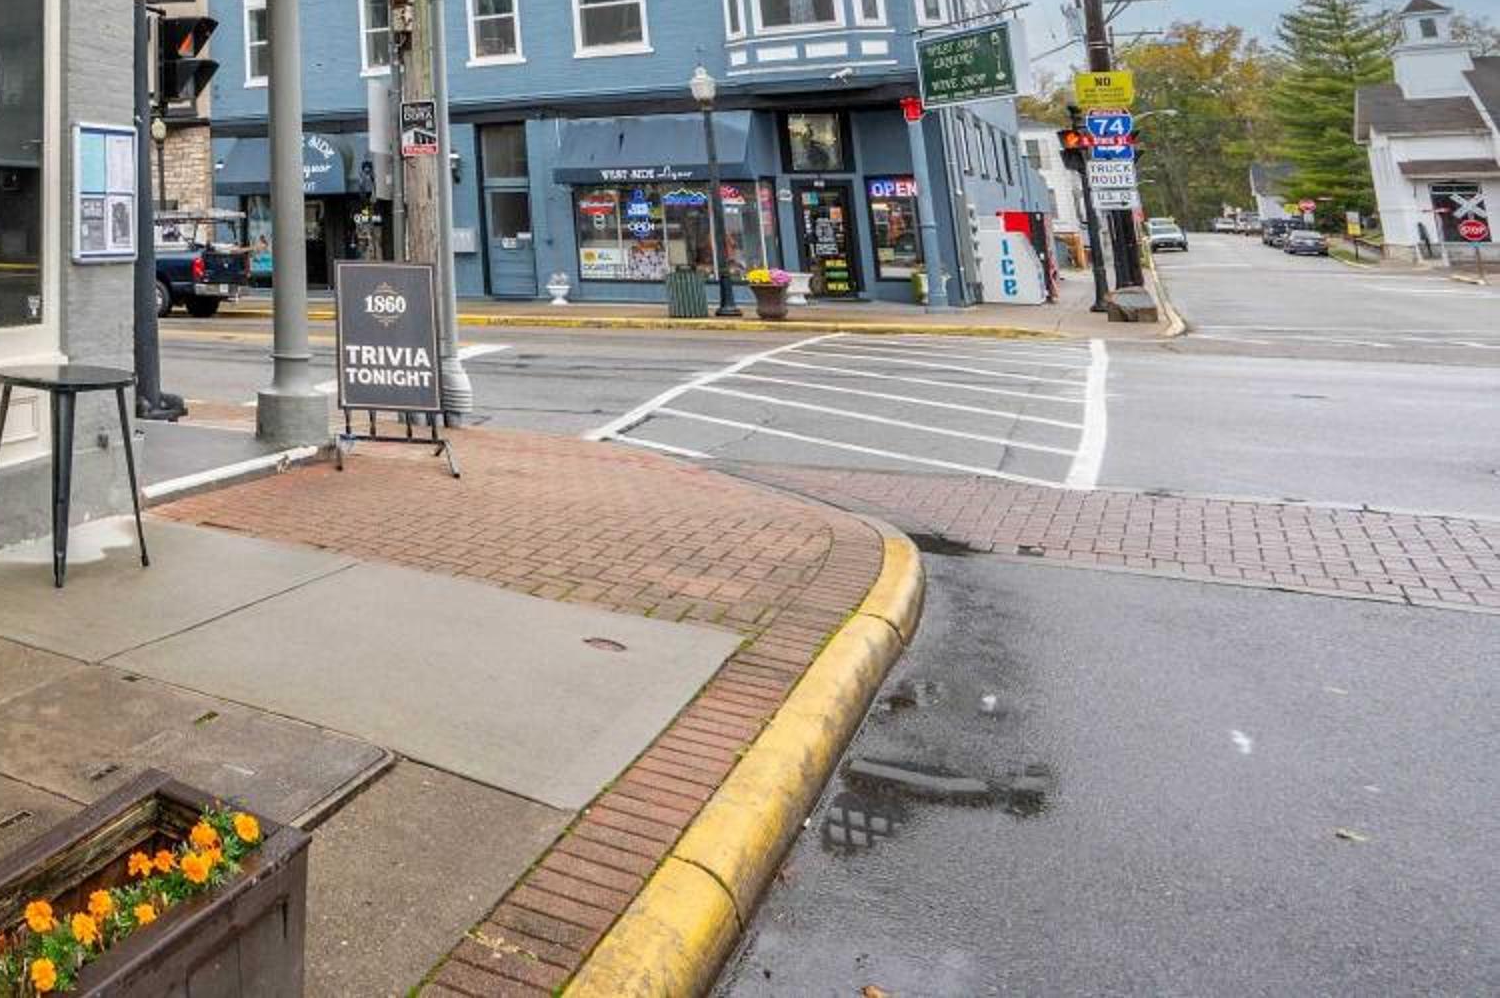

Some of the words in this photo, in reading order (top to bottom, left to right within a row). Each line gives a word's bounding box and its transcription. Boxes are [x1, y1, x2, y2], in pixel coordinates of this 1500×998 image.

[1094, 77, 1111, 87] NO
[1094, 118, 1124, 135] 74
[1091, 163, 1131, 173] TRUCK
[1091, 174, 1133, 185] ROUTE
[871, 180, 918, 197] OPEN
[1461, 224, 1486, 236] STOP
[364, 295, 407, 314] 1860
[346, 345, 432, 367] TRIVIA
[346, 368, 433, 387] TONIGHT
